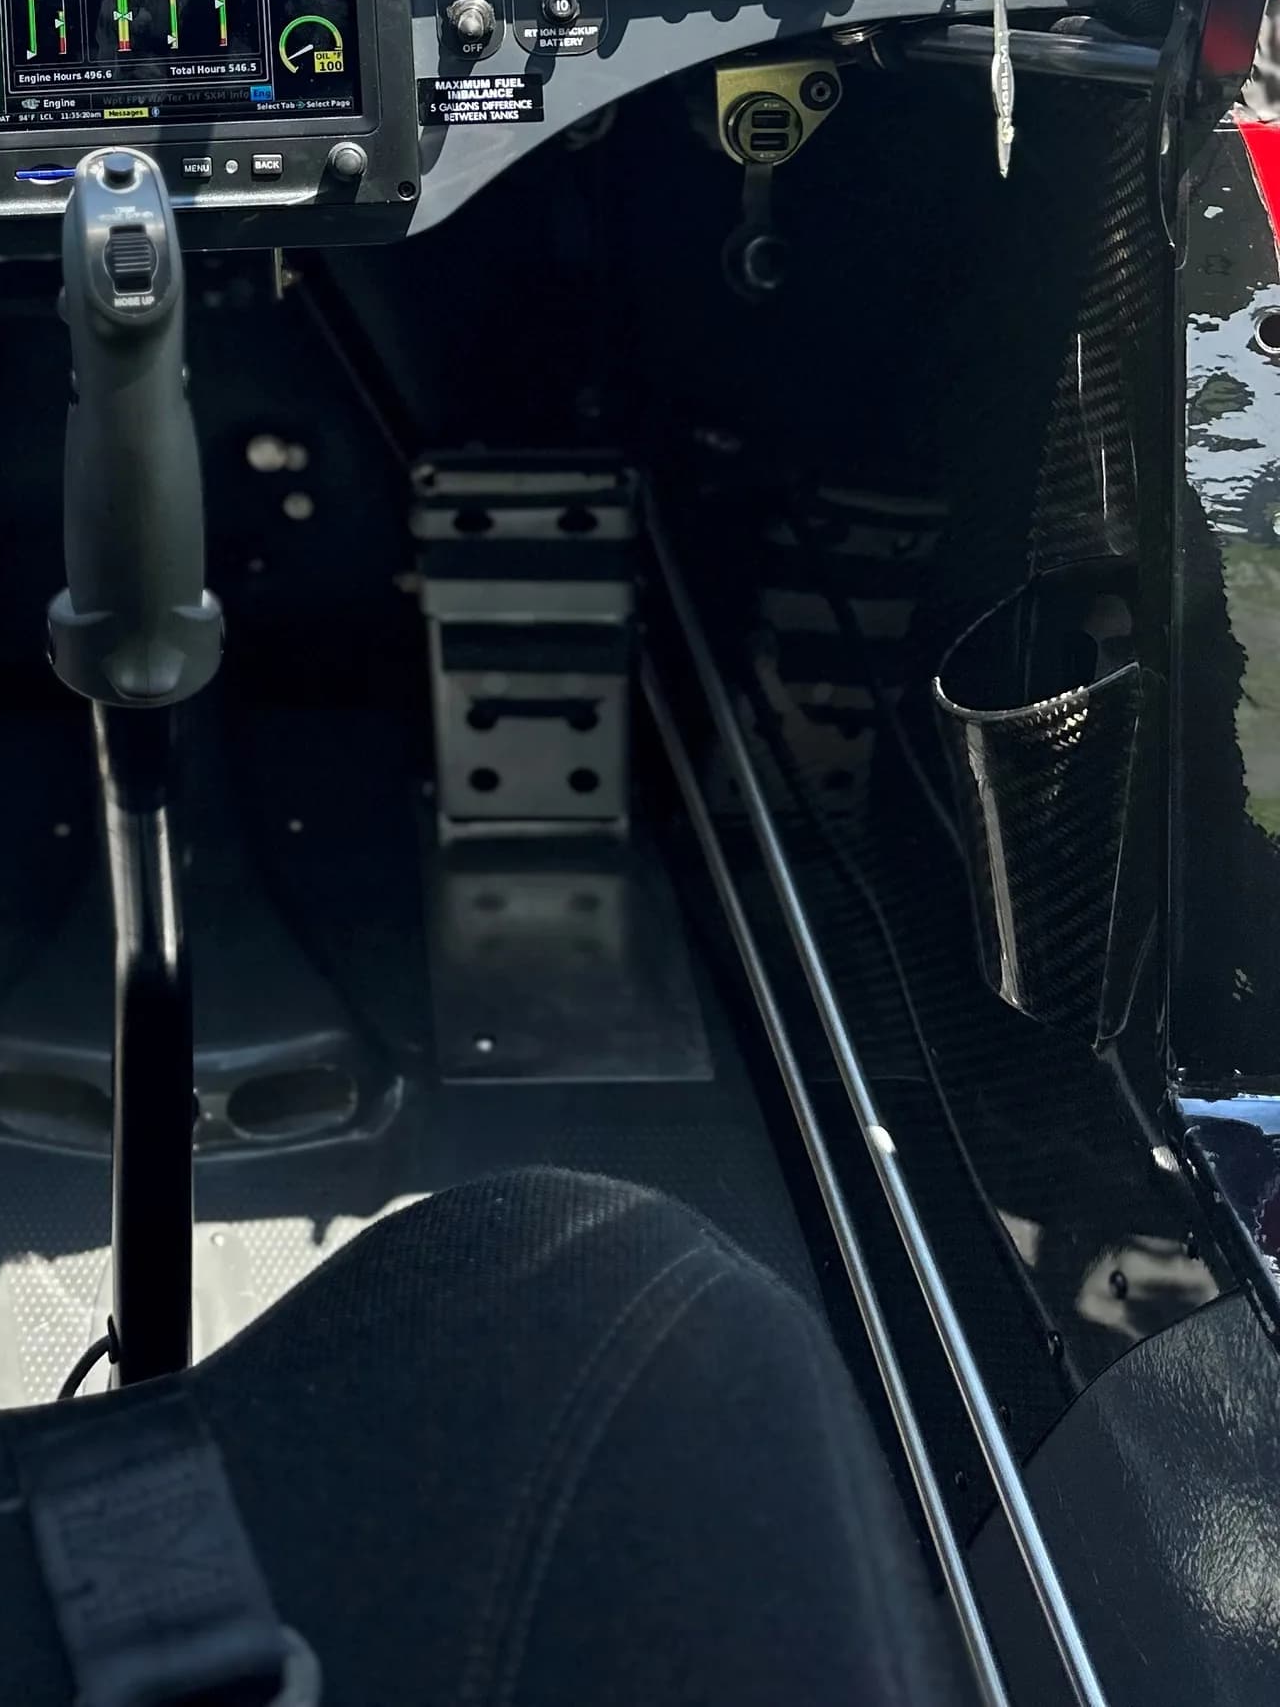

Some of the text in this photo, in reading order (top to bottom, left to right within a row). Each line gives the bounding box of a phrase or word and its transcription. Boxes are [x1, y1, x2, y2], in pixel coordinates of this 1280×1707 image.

[525, 27, 598, 37] RT IGN BACKUP
[540, 38, 583, 47] BATTERY
[463, 44, 483, 52] OFF
[170, 63, 256, 75] Total Hours 546.5
[320, 61, 342, 71] 100
[19, 70, 112, 84] Engine Hours 496.6
[435, 78, 524, 90] MAXIMUM FUEL
[448, 89, 513, 100] IMBALANCE
[43, 98, 75, 109] Engine
[257, 102, 279, 110] Select
[439, 102, 479, 111] GALLONS
[482, 100, 532, 110] DIFFERENCE
[444, 111, 519, 121] BETWEEN TANKS
[255, 161, 279, 169] BACK
